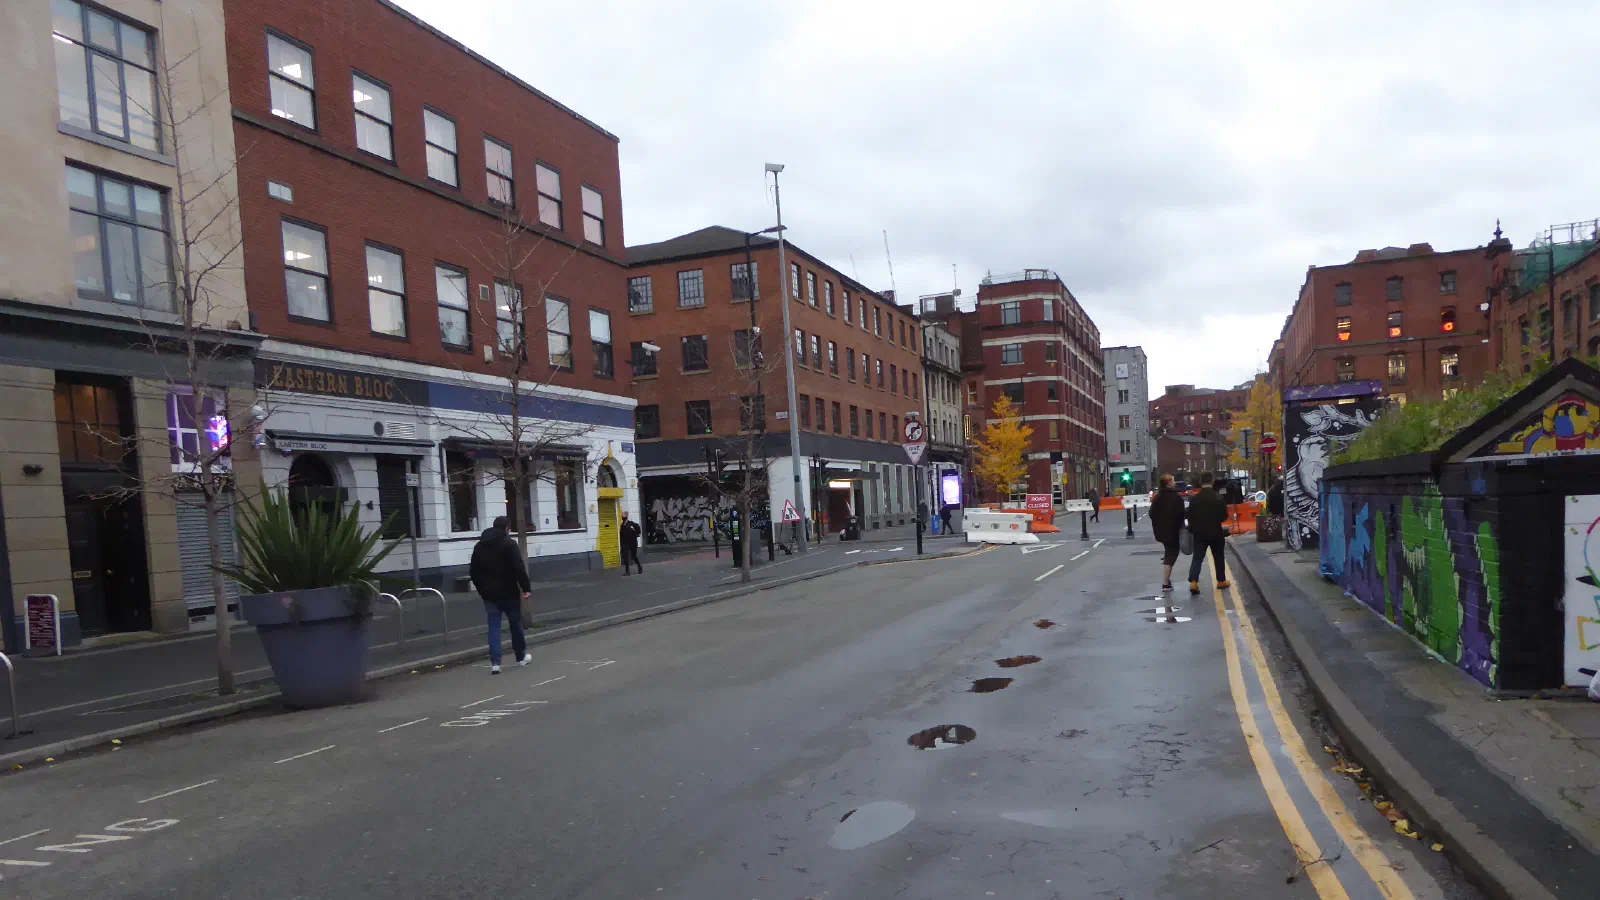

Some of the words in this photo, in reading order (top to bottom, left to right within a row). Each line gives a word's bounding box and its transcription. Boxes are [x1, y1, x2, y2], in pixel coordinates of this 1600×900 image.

[354, 376, 394, 400] BLOC
[439, 700, 549, 727] ONLY
[0, 818, 180, 870] ING
